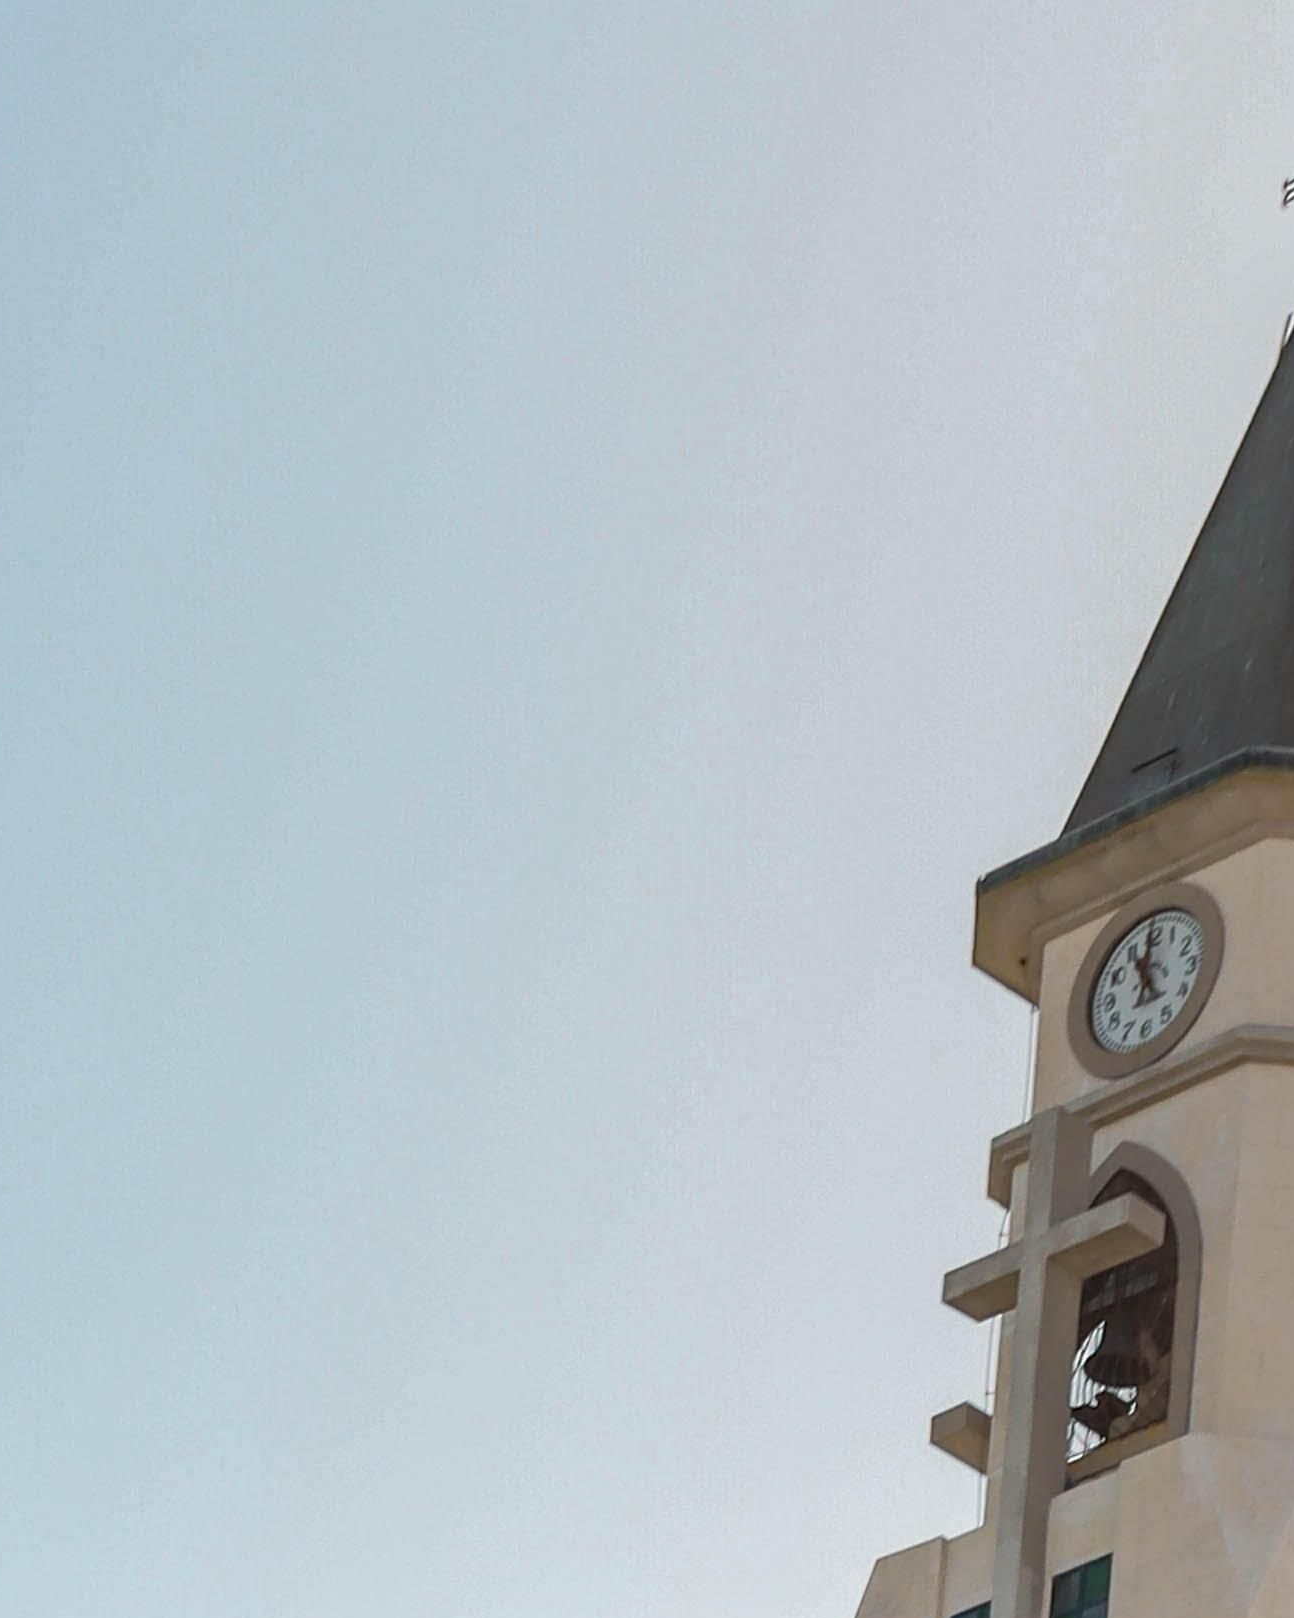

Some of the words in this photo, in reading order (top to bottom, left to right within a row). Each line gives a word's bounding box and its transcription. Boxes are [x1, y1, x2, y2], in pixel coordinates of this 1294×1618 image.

[1179, 935, 1193, 957] 2
[1185, 955, 1197, 976] 3
[1122, 1020, 1136, 1042] 7
